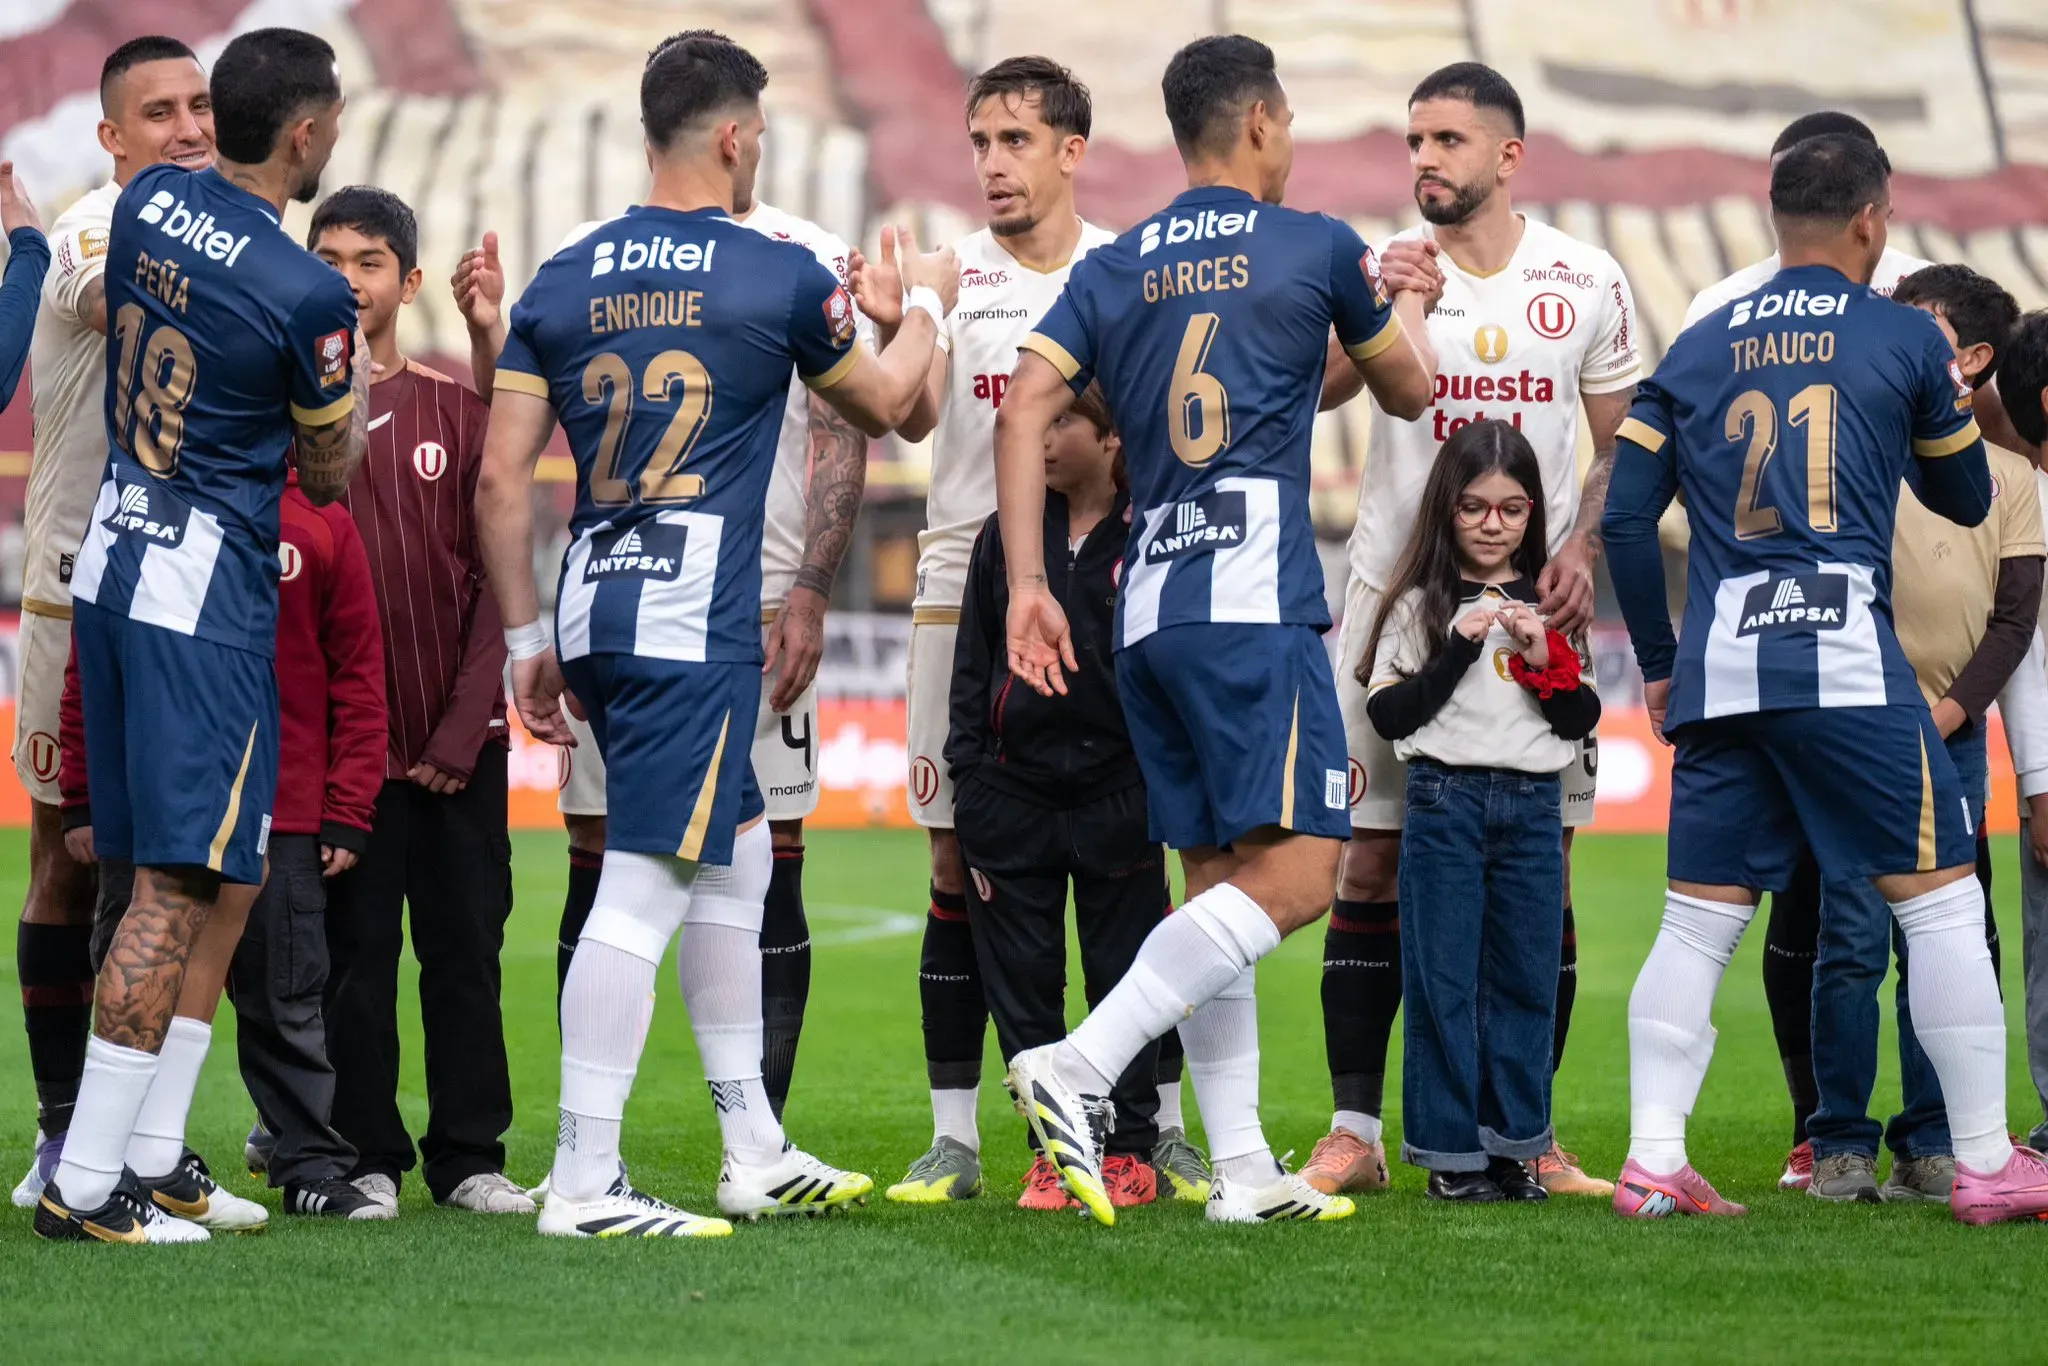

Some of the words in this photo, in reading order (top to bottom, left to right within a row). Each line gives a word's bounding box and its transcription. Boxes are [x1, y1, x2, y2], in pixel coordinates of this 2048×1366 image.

[161, 200, 251, 267] bitel
[1166, 210, 1258, 246] bitel
[620, 236, 716, 272] bitel
[135, 251, 190, 313] PEÑA
[960, 270, 1008, 288] CARLOS
[1143, 254, 1249, 304] GARCES
[1523, 269, 1547, 282] SAN
[1549, 270, 1594, 290] CARLOS
[590, 290, 704, 334] ENRIQUE
[959, 309, 1028, 321] marathon
[1539, 302, 1564, 333] U
[1730, 331, 1835, 374] TRAUCO
[114, 302, 196, 479] 18
[1168, 312, 1231, 469] 6
[582, 349, 713, 507] 22
[1433, 409, 1521, 442] tol
[420, 448, 442, 477] U
[1725, 383, 1838, 541] 21
[1150, 526, 1239, 556] ANYPSA
[587, 556, 673, 575] ANYPSA
[1743, 607, 1839, 629] ANYPSA
[33, 739, 53, 777] U
[781, 711, 812, 774] 4
[913, 765, 929, 800] U
[1323, 959, 1390, 968] arathon
